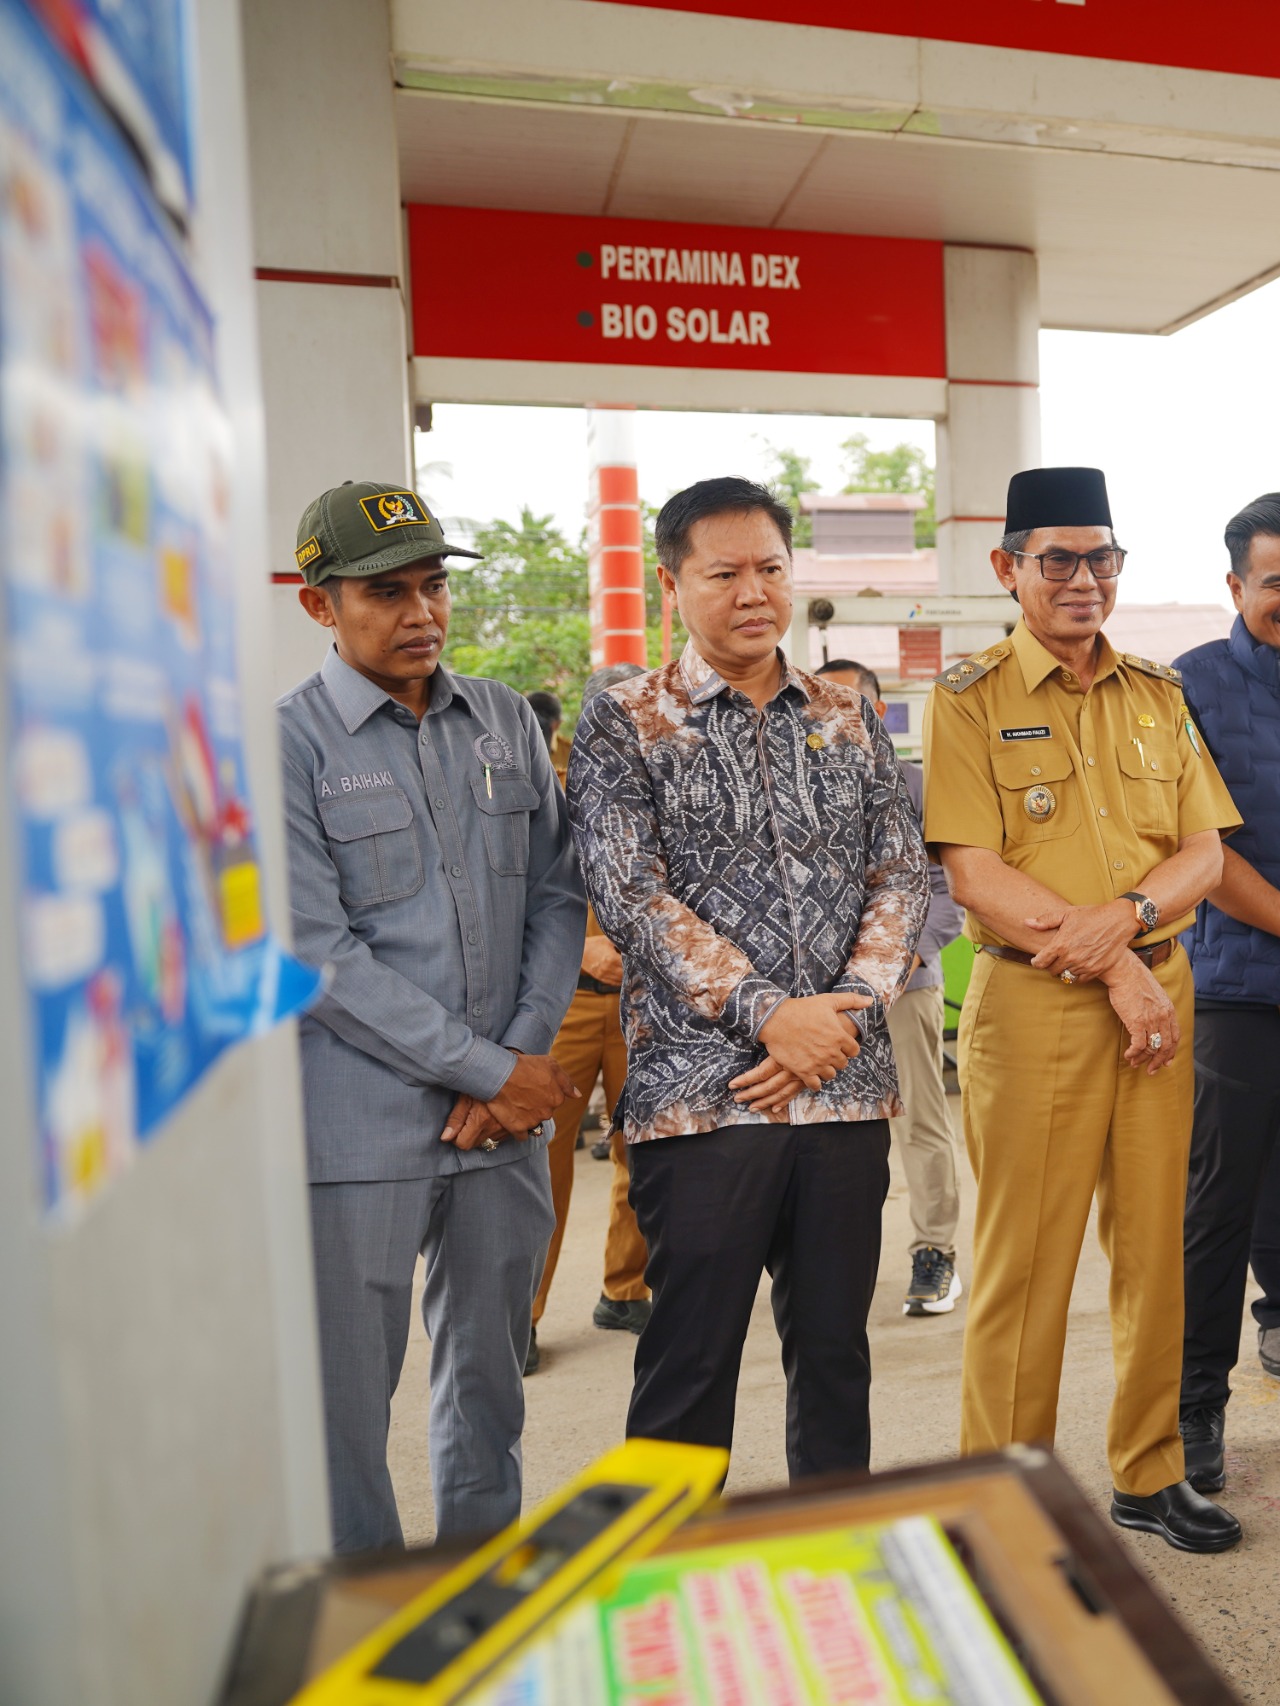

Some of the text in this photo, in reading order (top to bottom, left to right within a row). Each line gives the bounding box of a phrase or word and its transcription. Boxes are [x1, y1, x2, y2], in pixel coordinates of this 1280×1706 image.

[601, 244, 801, 290] PERTAMINA DEX
[601, 303, 771, 346] BIO SOLAR
[298, 543, 316, 564] DPRD
[321, 771, 394, 797] A. BAIHAKI
